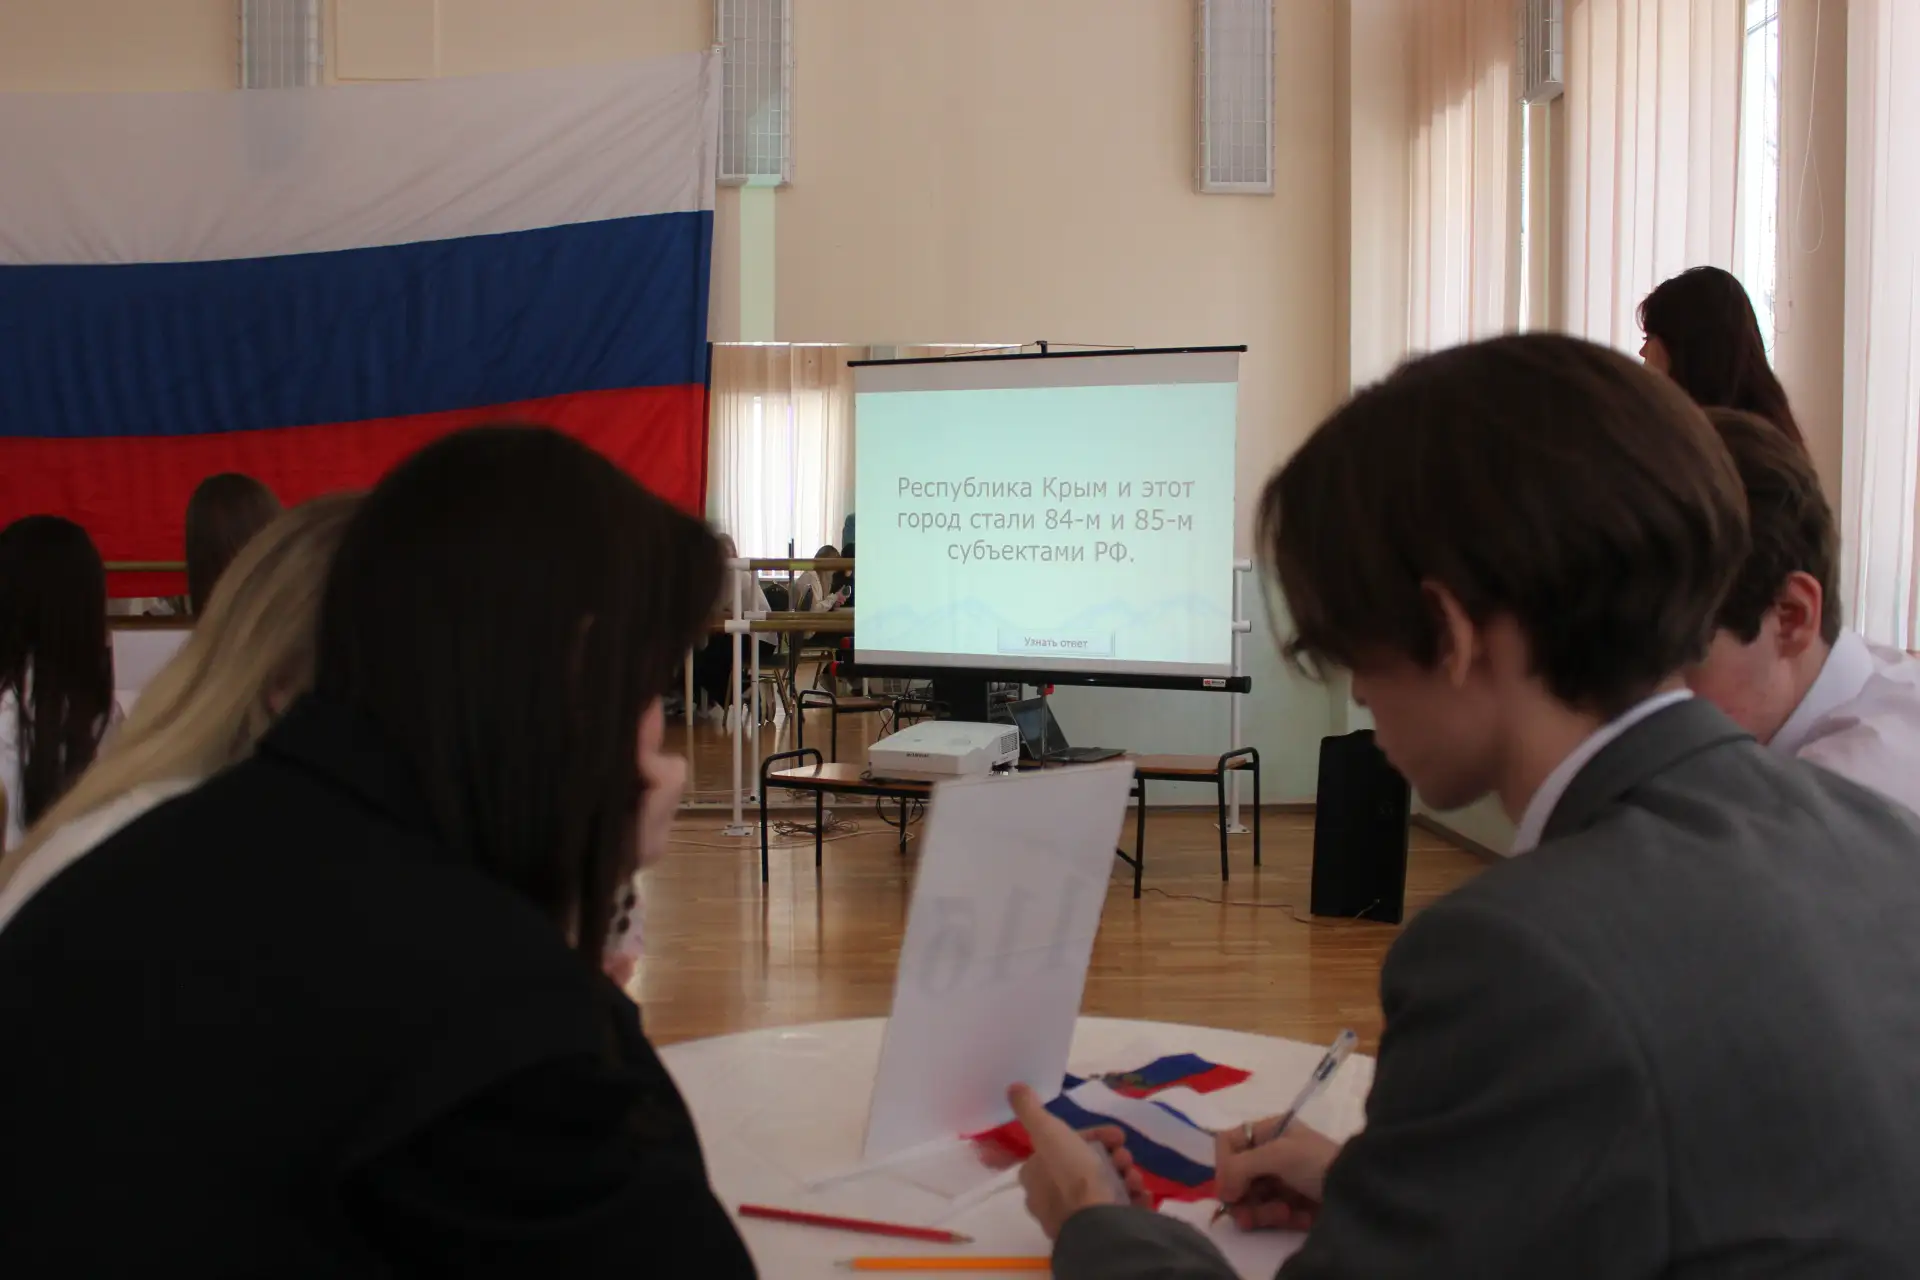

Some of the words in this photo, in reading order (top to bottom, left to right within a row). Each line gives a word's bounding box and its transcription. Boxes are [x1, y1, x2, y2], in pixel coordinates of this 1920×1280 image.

[898, 476, 1033, 502] Республика
[1042, 476, 1107, 502] Крым
[1118, 481, 1132, 498] и
[1141, 480, 1195, 499] этот
[897, 512, 962, 533] город
[969, 512, 1035, 530] стали
[1044, 508, 1101, 530] 84-м
[1111, 513, 1125, 531] и
[1134, 508, 1193, 532] 85-м
[947, 538, 1084, 565] субъектами
[1094, 541, 1135, 563] РФ.
[1024, 636, 1058, 648] Узнать
[1060, 638, 1088, 649] ответ
